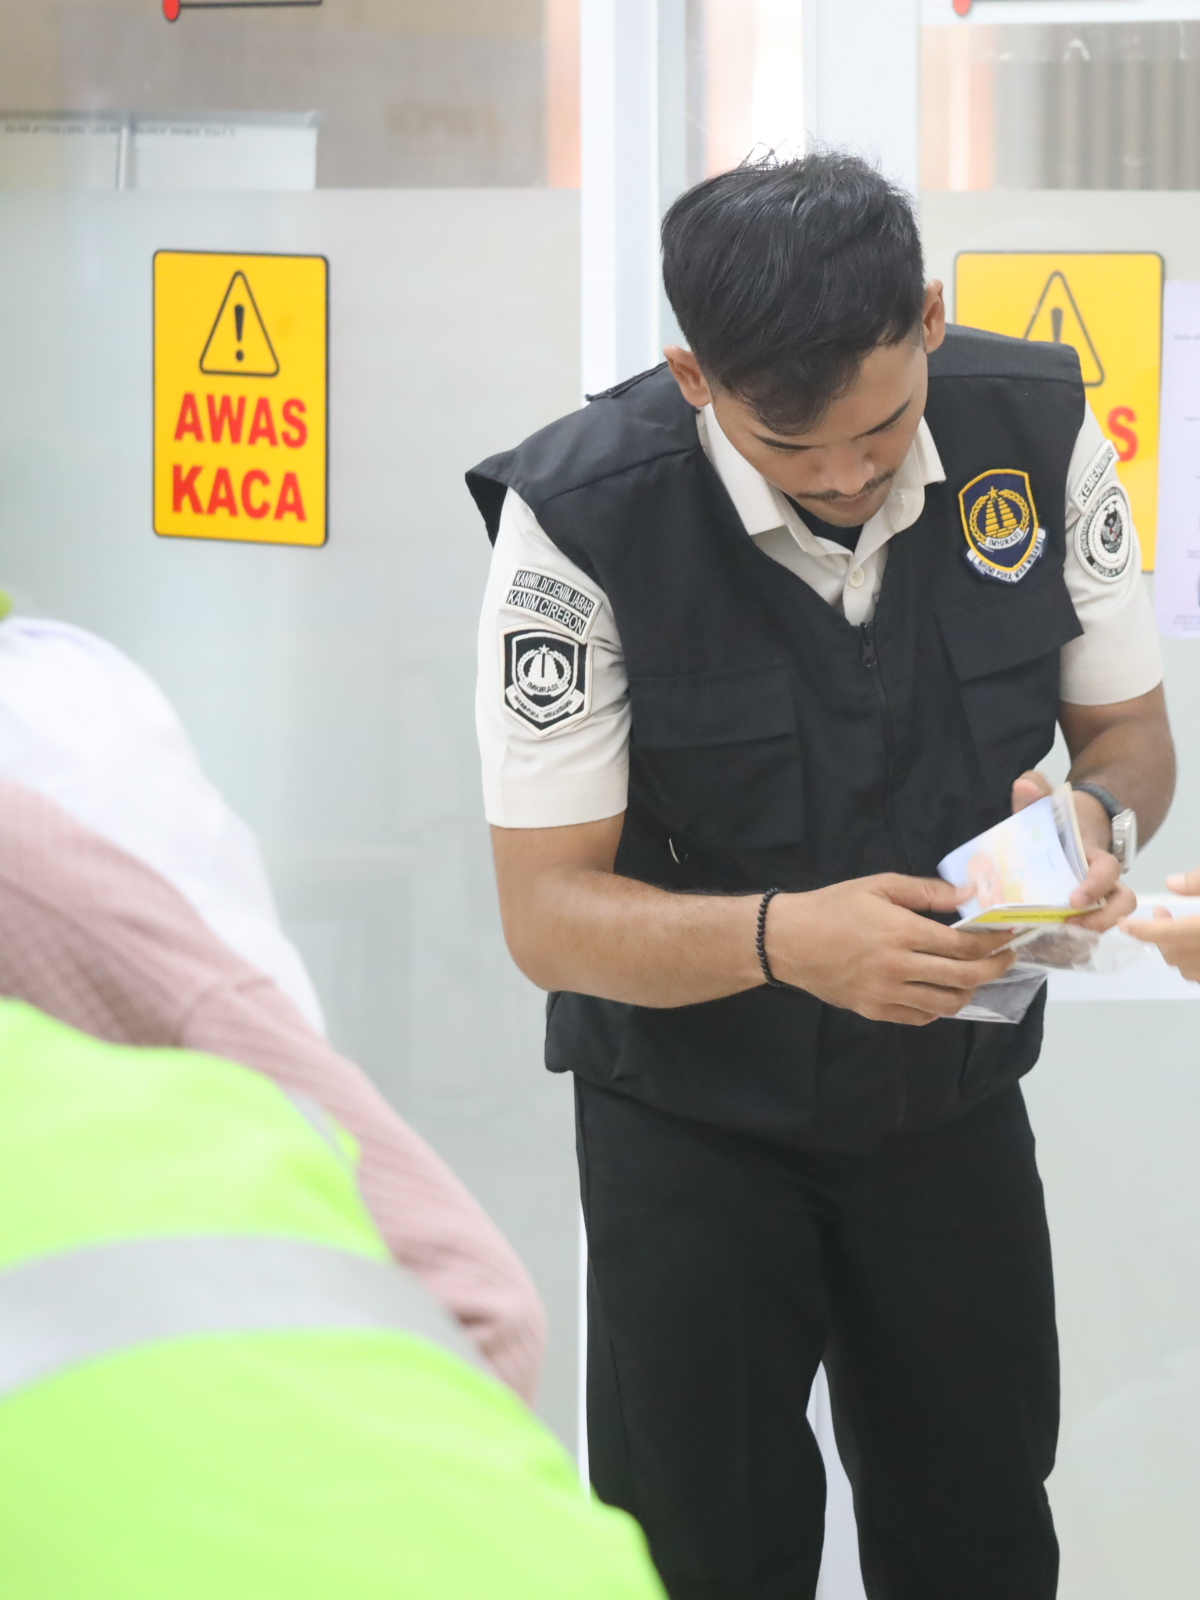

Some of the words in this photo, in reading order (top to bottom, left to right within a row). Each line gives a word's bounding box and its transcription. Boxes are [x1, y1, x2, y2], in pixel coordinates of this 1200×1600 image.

[174, 392, 308, 449] AWAS
[172, 464, 307, 522] KACA
[507, 590, 541, 611] KANIM
[539, 600, 587, 636] CIREBON
[570, 591, 594, 617] JABAR
